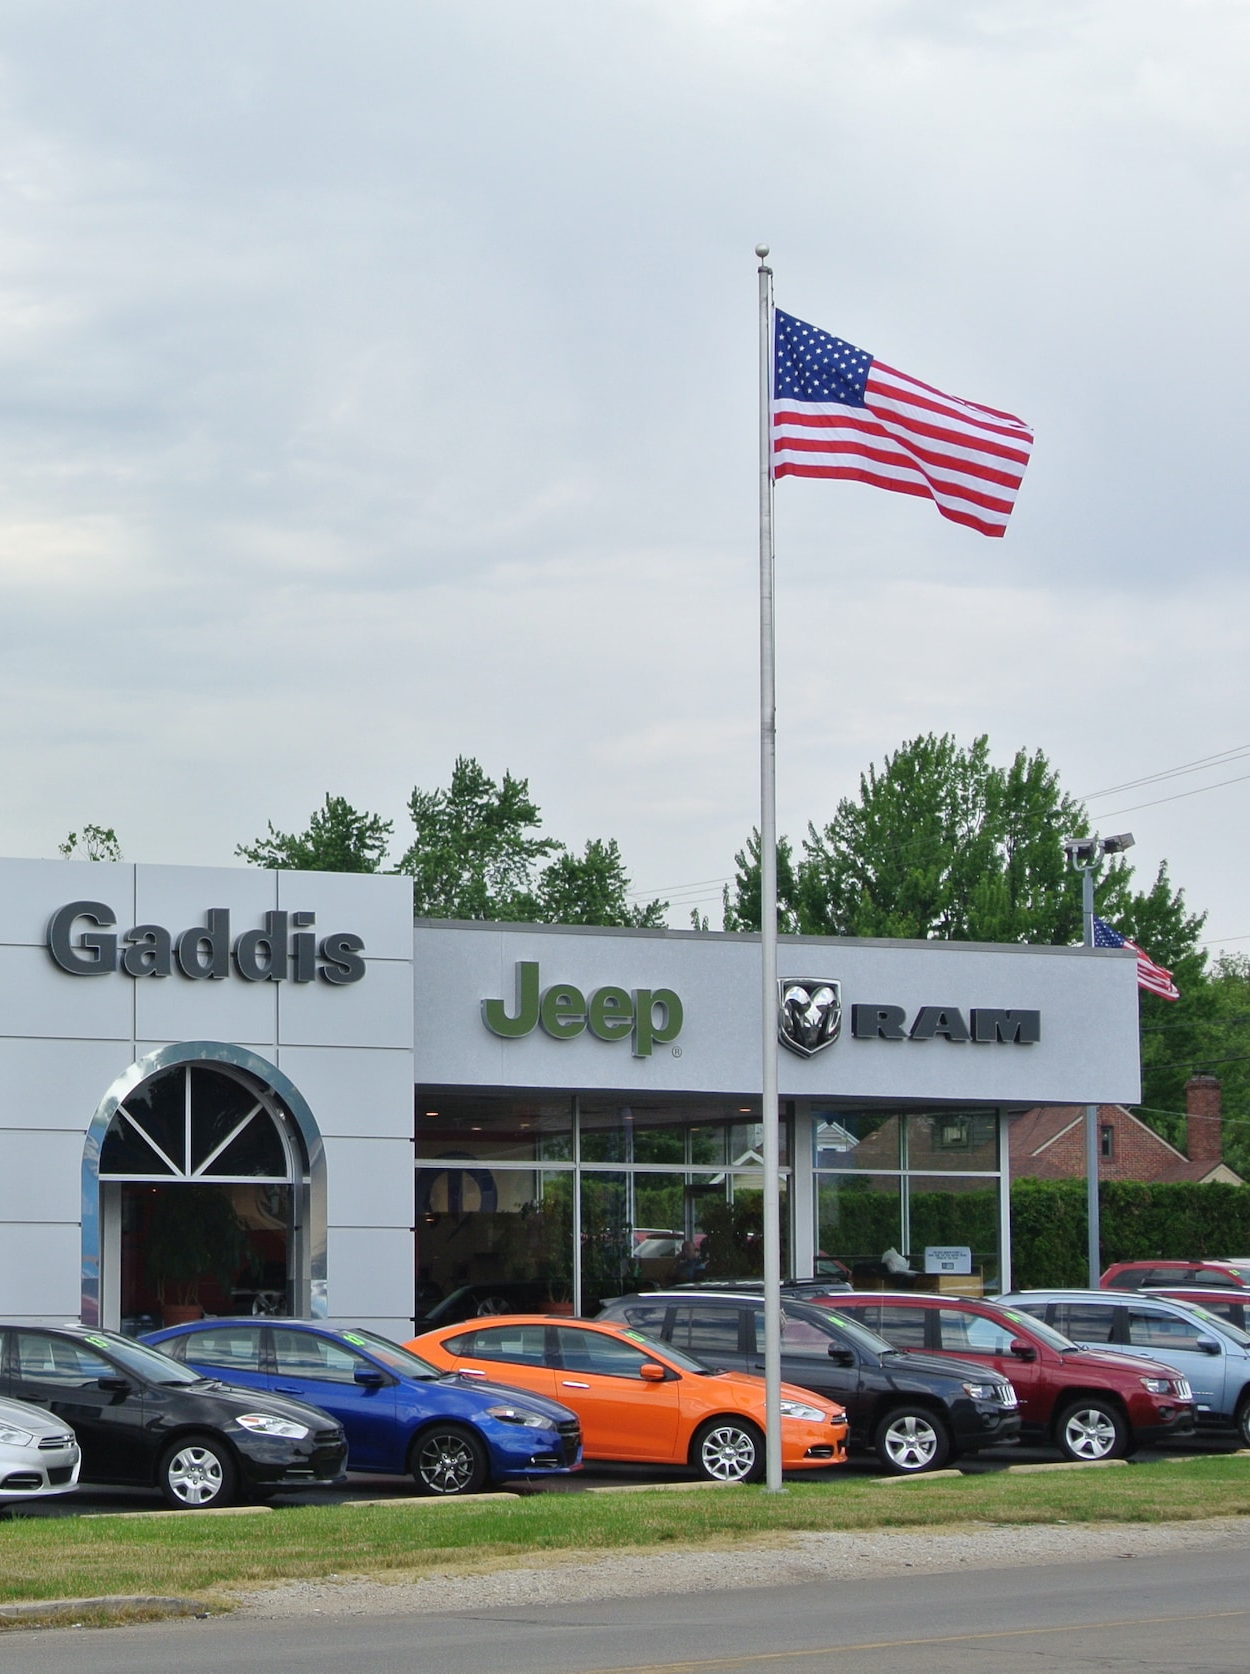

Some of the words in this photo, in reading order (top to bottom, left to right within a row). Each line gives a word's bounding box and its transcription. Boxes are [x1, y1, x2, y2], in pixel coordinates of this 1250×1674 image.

[46, 900, 367, 985] Gaddis
[481, 961, 684, 1058] Jeep
[851, 1003, 1041, 1042] RAM
